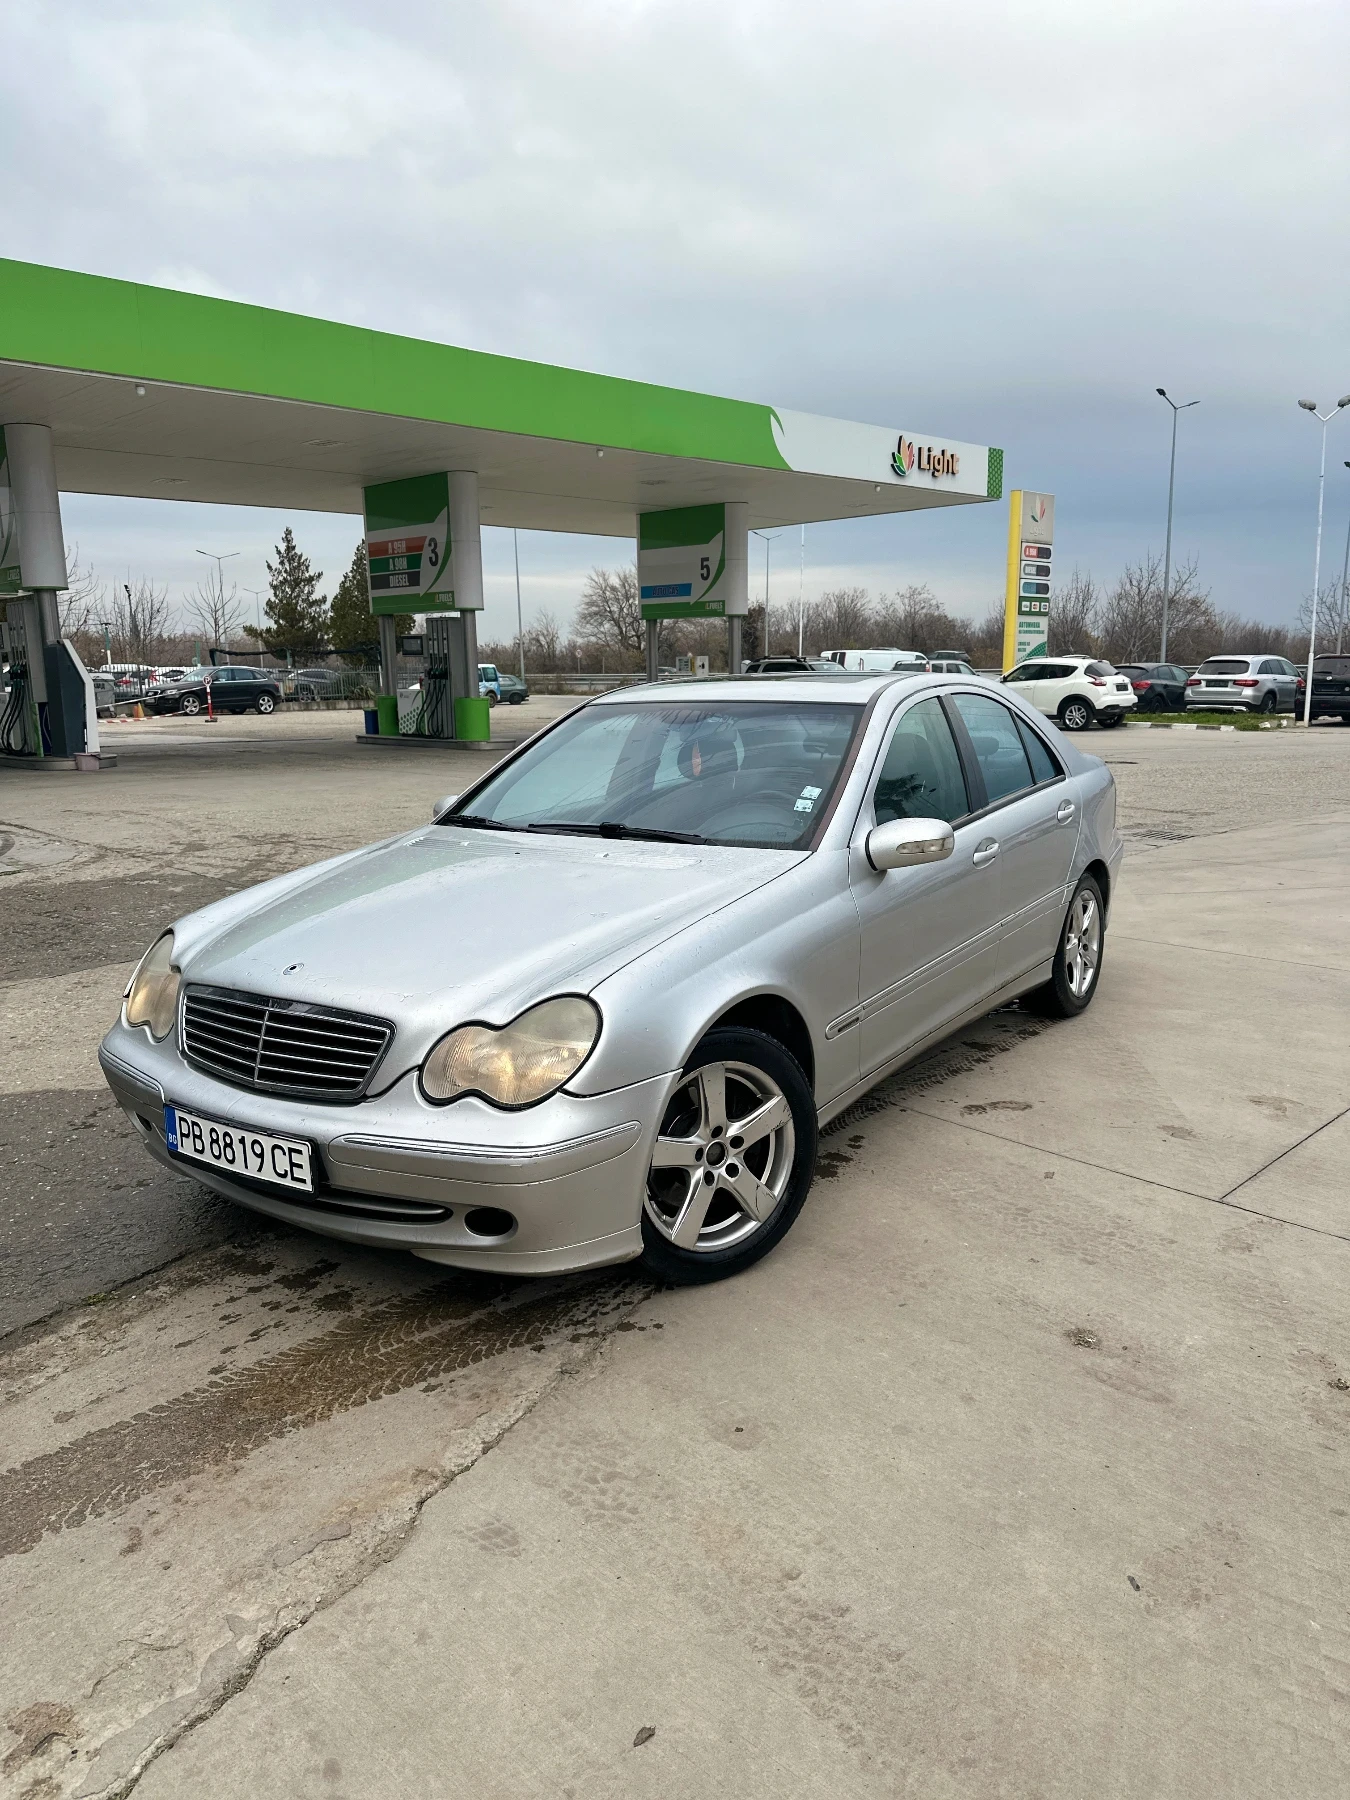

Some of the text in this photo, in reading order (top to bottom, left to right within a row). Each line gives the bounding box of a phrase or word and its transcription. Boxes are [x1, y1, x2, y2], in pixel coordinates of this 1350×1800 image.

[918, 446, 960, 478] Light
[388, 542, 393, 554] A
[428, 537, 439, 566] 3
[389, 558, 394, 571] A
[700, 557, 710, 581] 5
[390, 574, 409, 587] DIESEL
[652, 586, 679, 596] AUTO GAS
[168, 1132, 178, 1145] BG
[178, 1115, 307, 1185] PB 8819 CE
